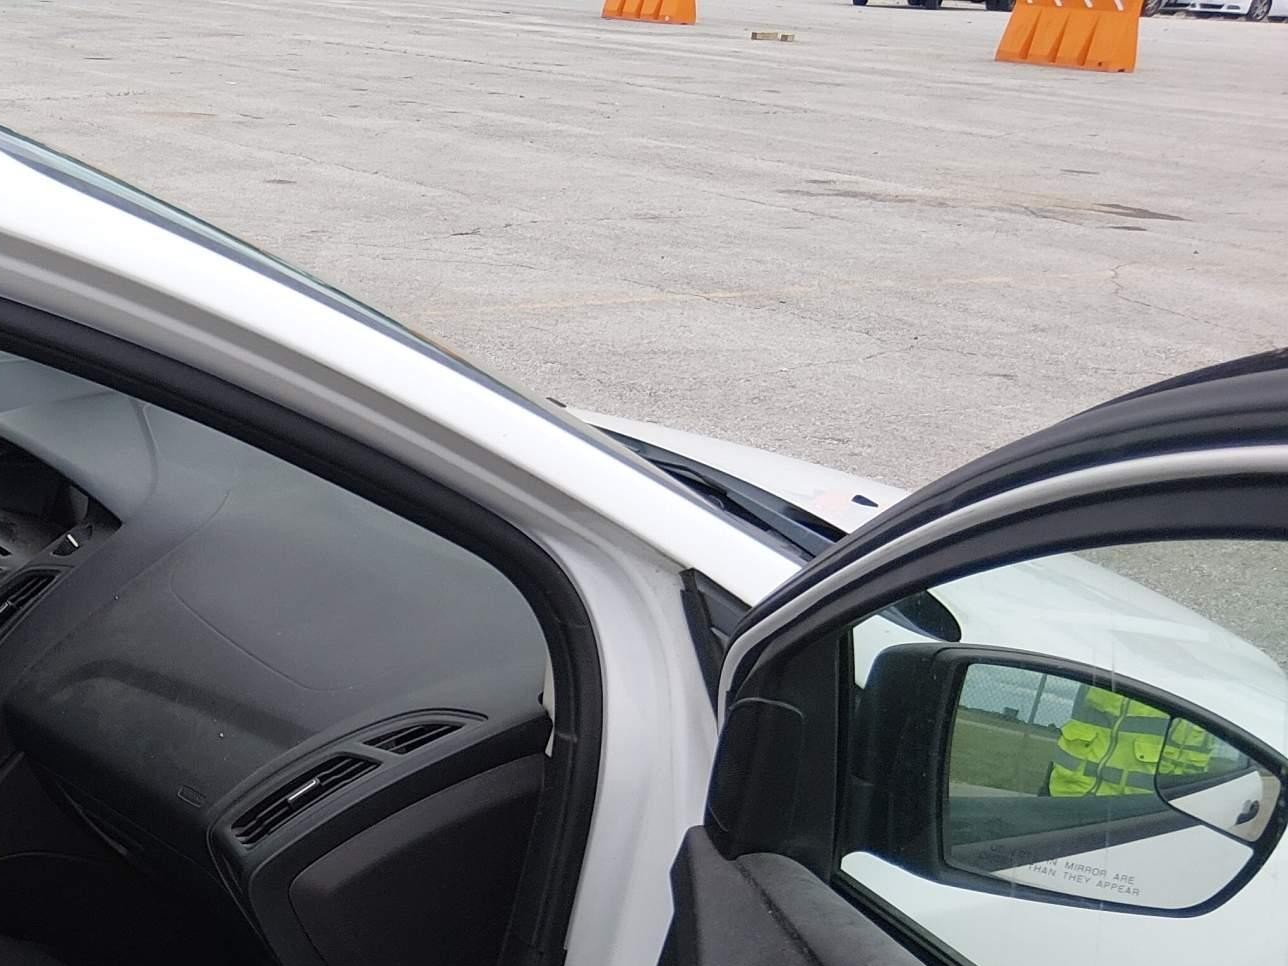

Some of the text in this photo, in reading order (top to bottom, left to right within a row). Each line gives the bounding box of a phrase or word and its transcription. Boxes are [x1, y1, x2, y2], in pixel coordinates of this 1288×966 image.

[1063, 872, 1091, 884] THEY
[1096, 880, 1140, 896] APPEAR
[1064, 861, 1108, 878] MIRROR
[1113, 873, 1136, 885] ARE
